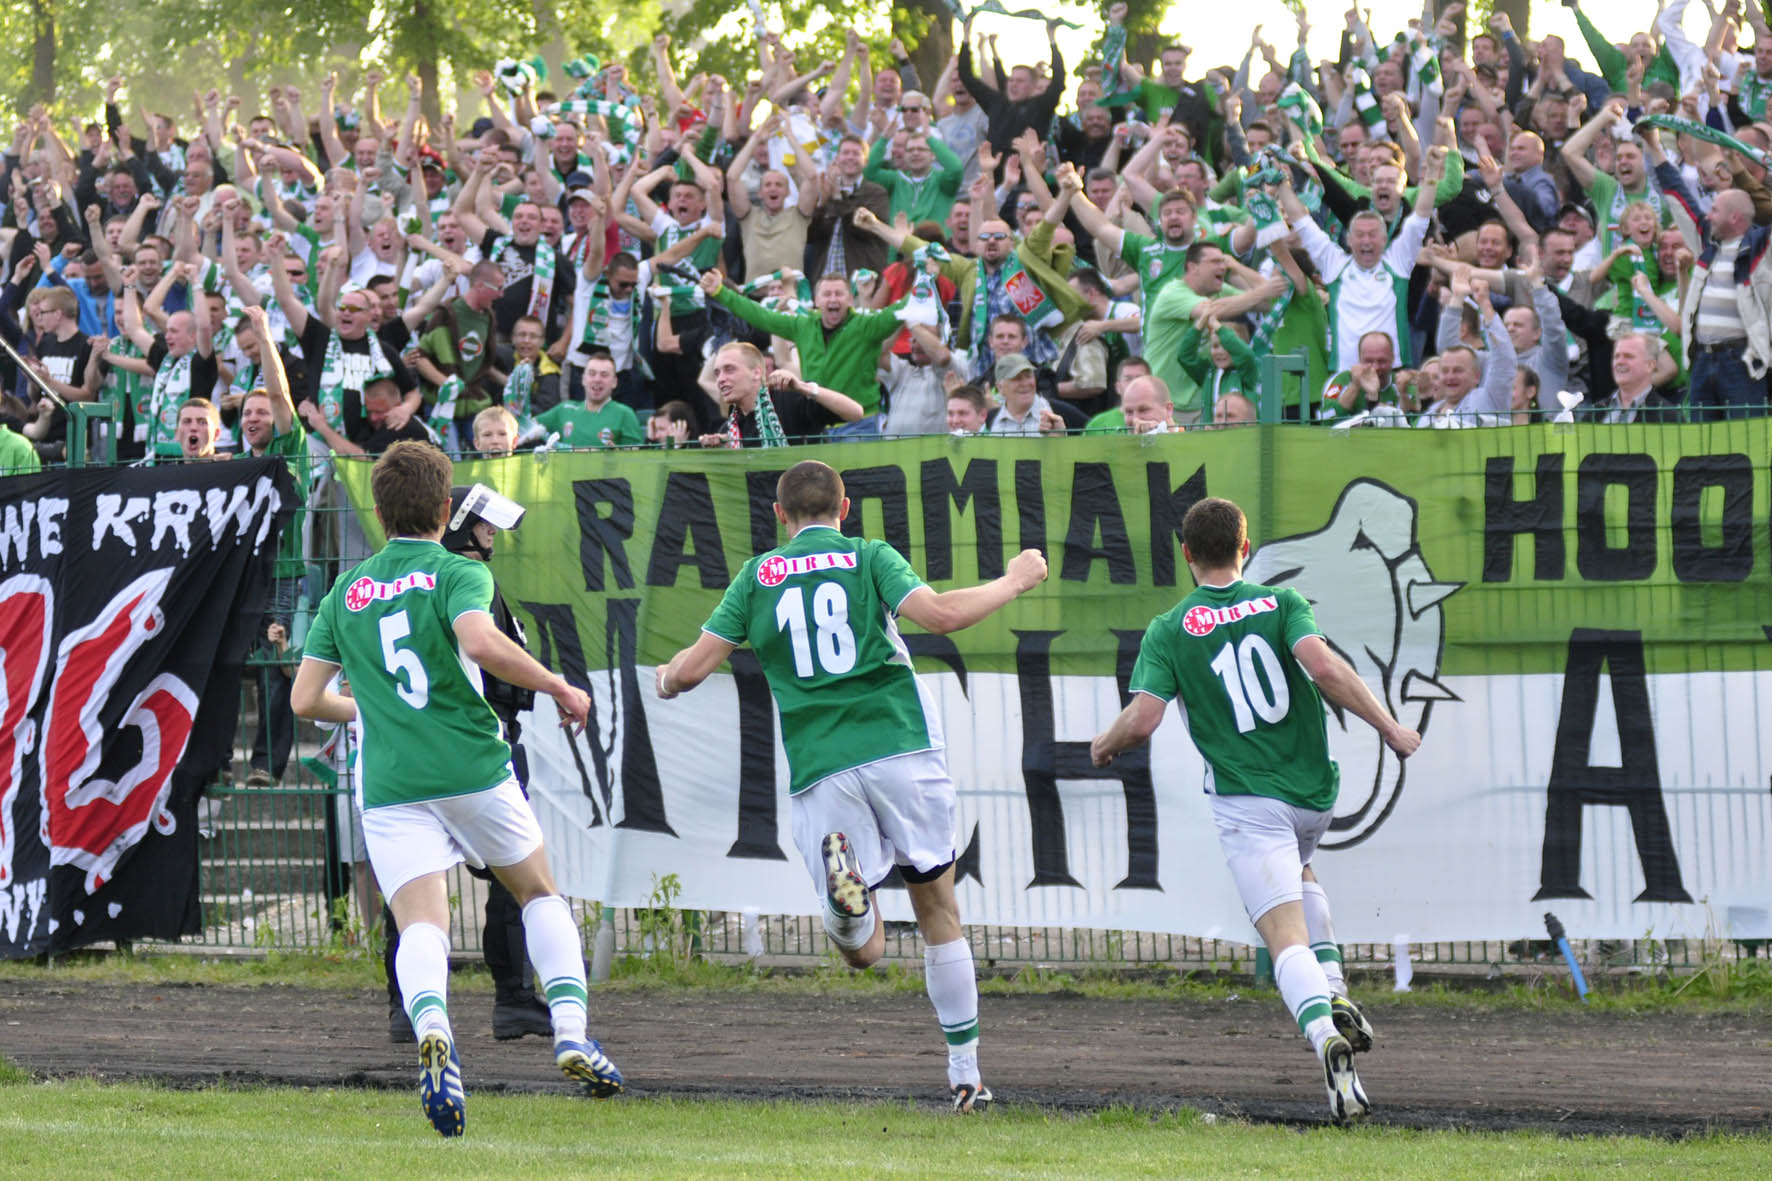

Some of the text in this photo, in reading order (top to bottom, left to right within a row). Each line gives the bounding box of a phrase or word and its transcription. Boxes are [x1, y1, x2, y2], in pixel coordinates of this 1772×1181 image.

[1482, 453, 1772, 582] HOO
[378, 609, 428, 711] 5
[775, 581, 857, 678] 18
[1210, 632, 1291, 734] 10
